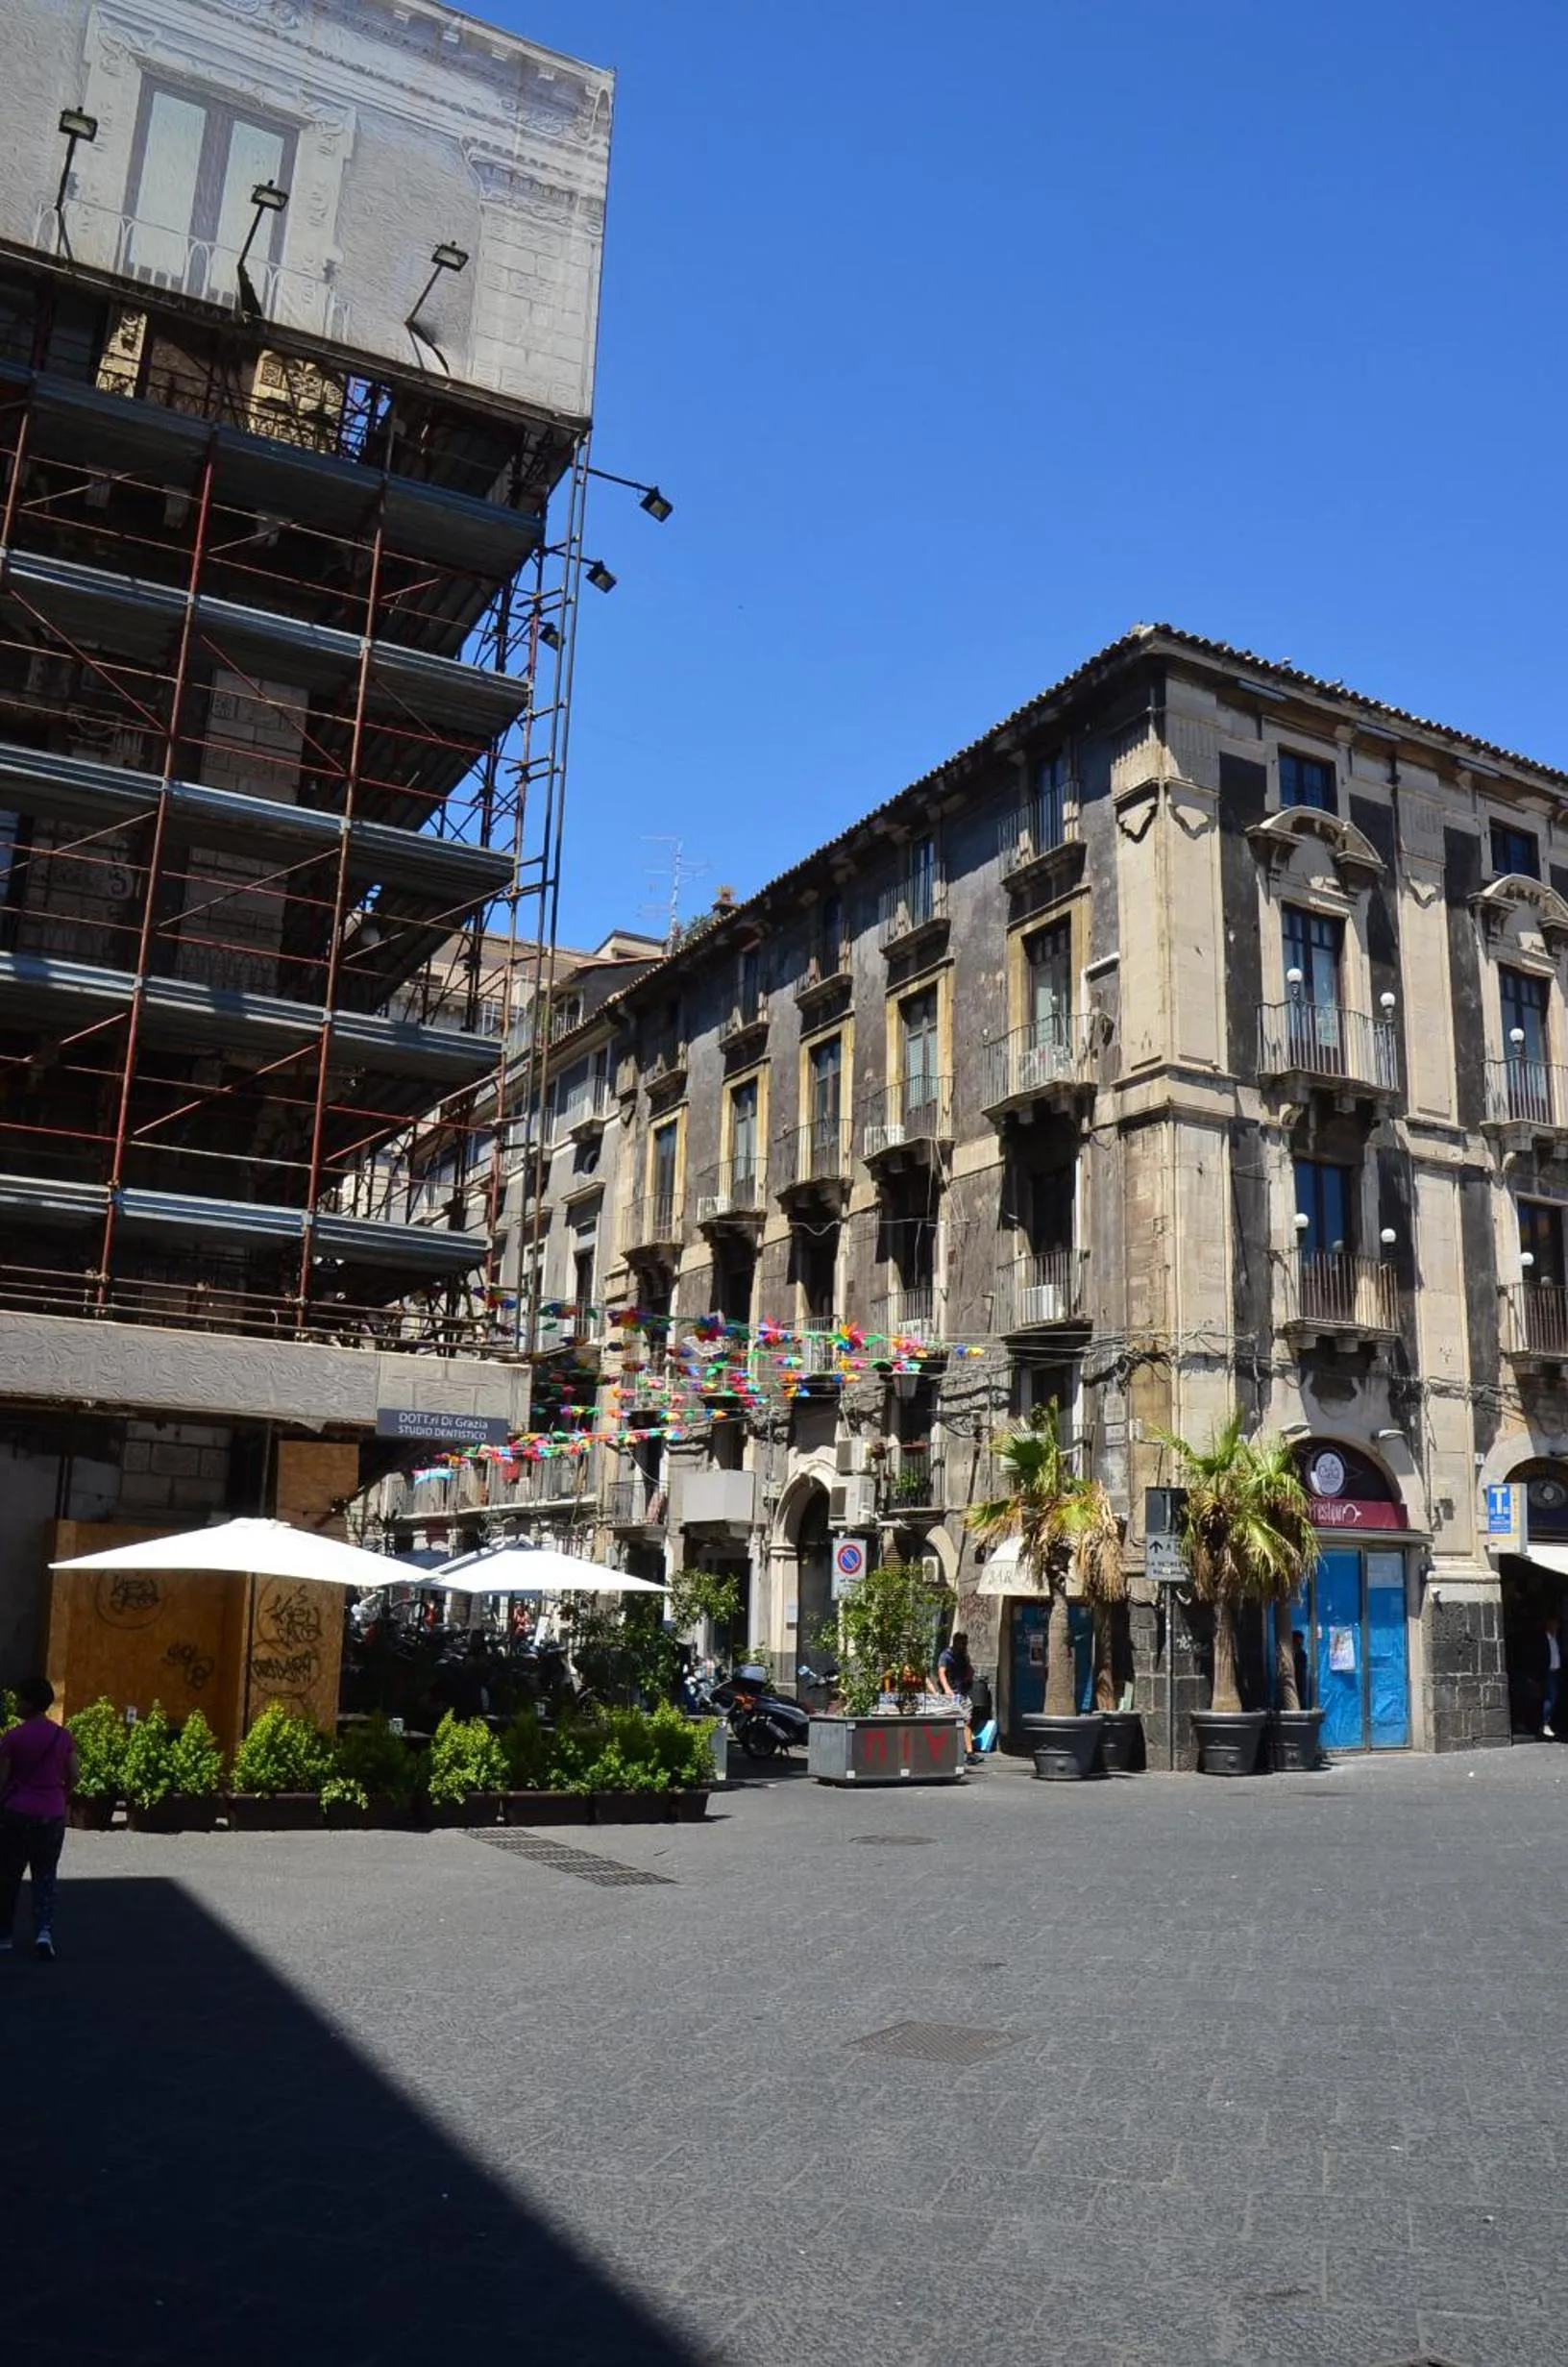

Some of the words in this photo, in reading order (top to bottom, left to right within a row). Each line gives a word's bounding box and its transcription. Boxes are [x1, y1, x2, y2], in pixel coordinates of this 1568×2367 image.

[441, 1416, 453, 1427] Di
[455, 1418, 488, 1429] Grazia
[399, 1425, 432, 1436] STUDIO
[434, 1428, 486, 1440] DENTISTICO
